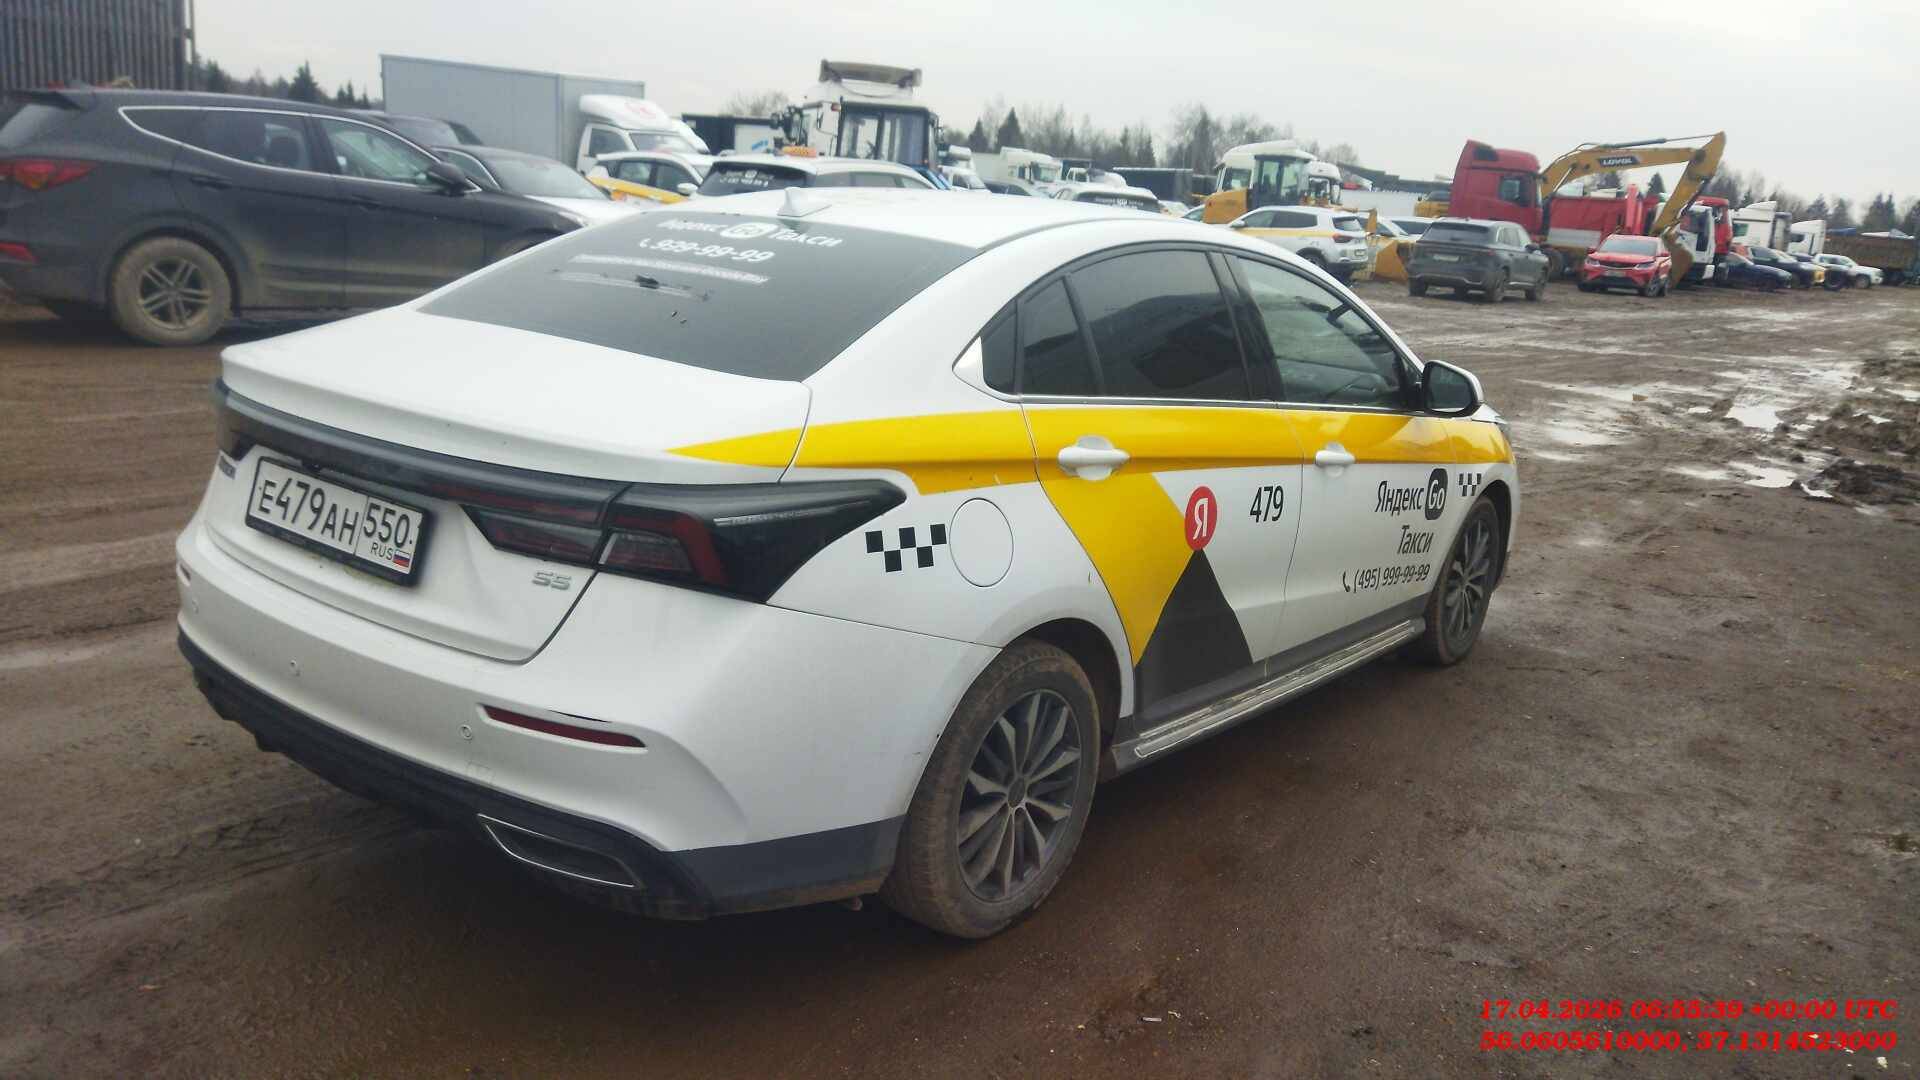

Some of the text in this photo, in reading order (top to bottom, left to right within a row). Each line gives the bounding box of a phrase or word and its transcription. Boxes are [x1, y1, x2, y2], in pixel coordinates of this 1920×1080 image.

[257, 477, 359, 546] Е479АН
[1249, 485, 1284, 523] 479
[1375, 478, 1446, 514] Яндекс Go
[363, 502, 411, 549] 550
[1192, 497, 1209, 540] Я
[370, 541, 393, 562] RUS
[1397, 524, 1434, 555] Такси
[1353, 563, 1431, 594] (495) 999-99-99
